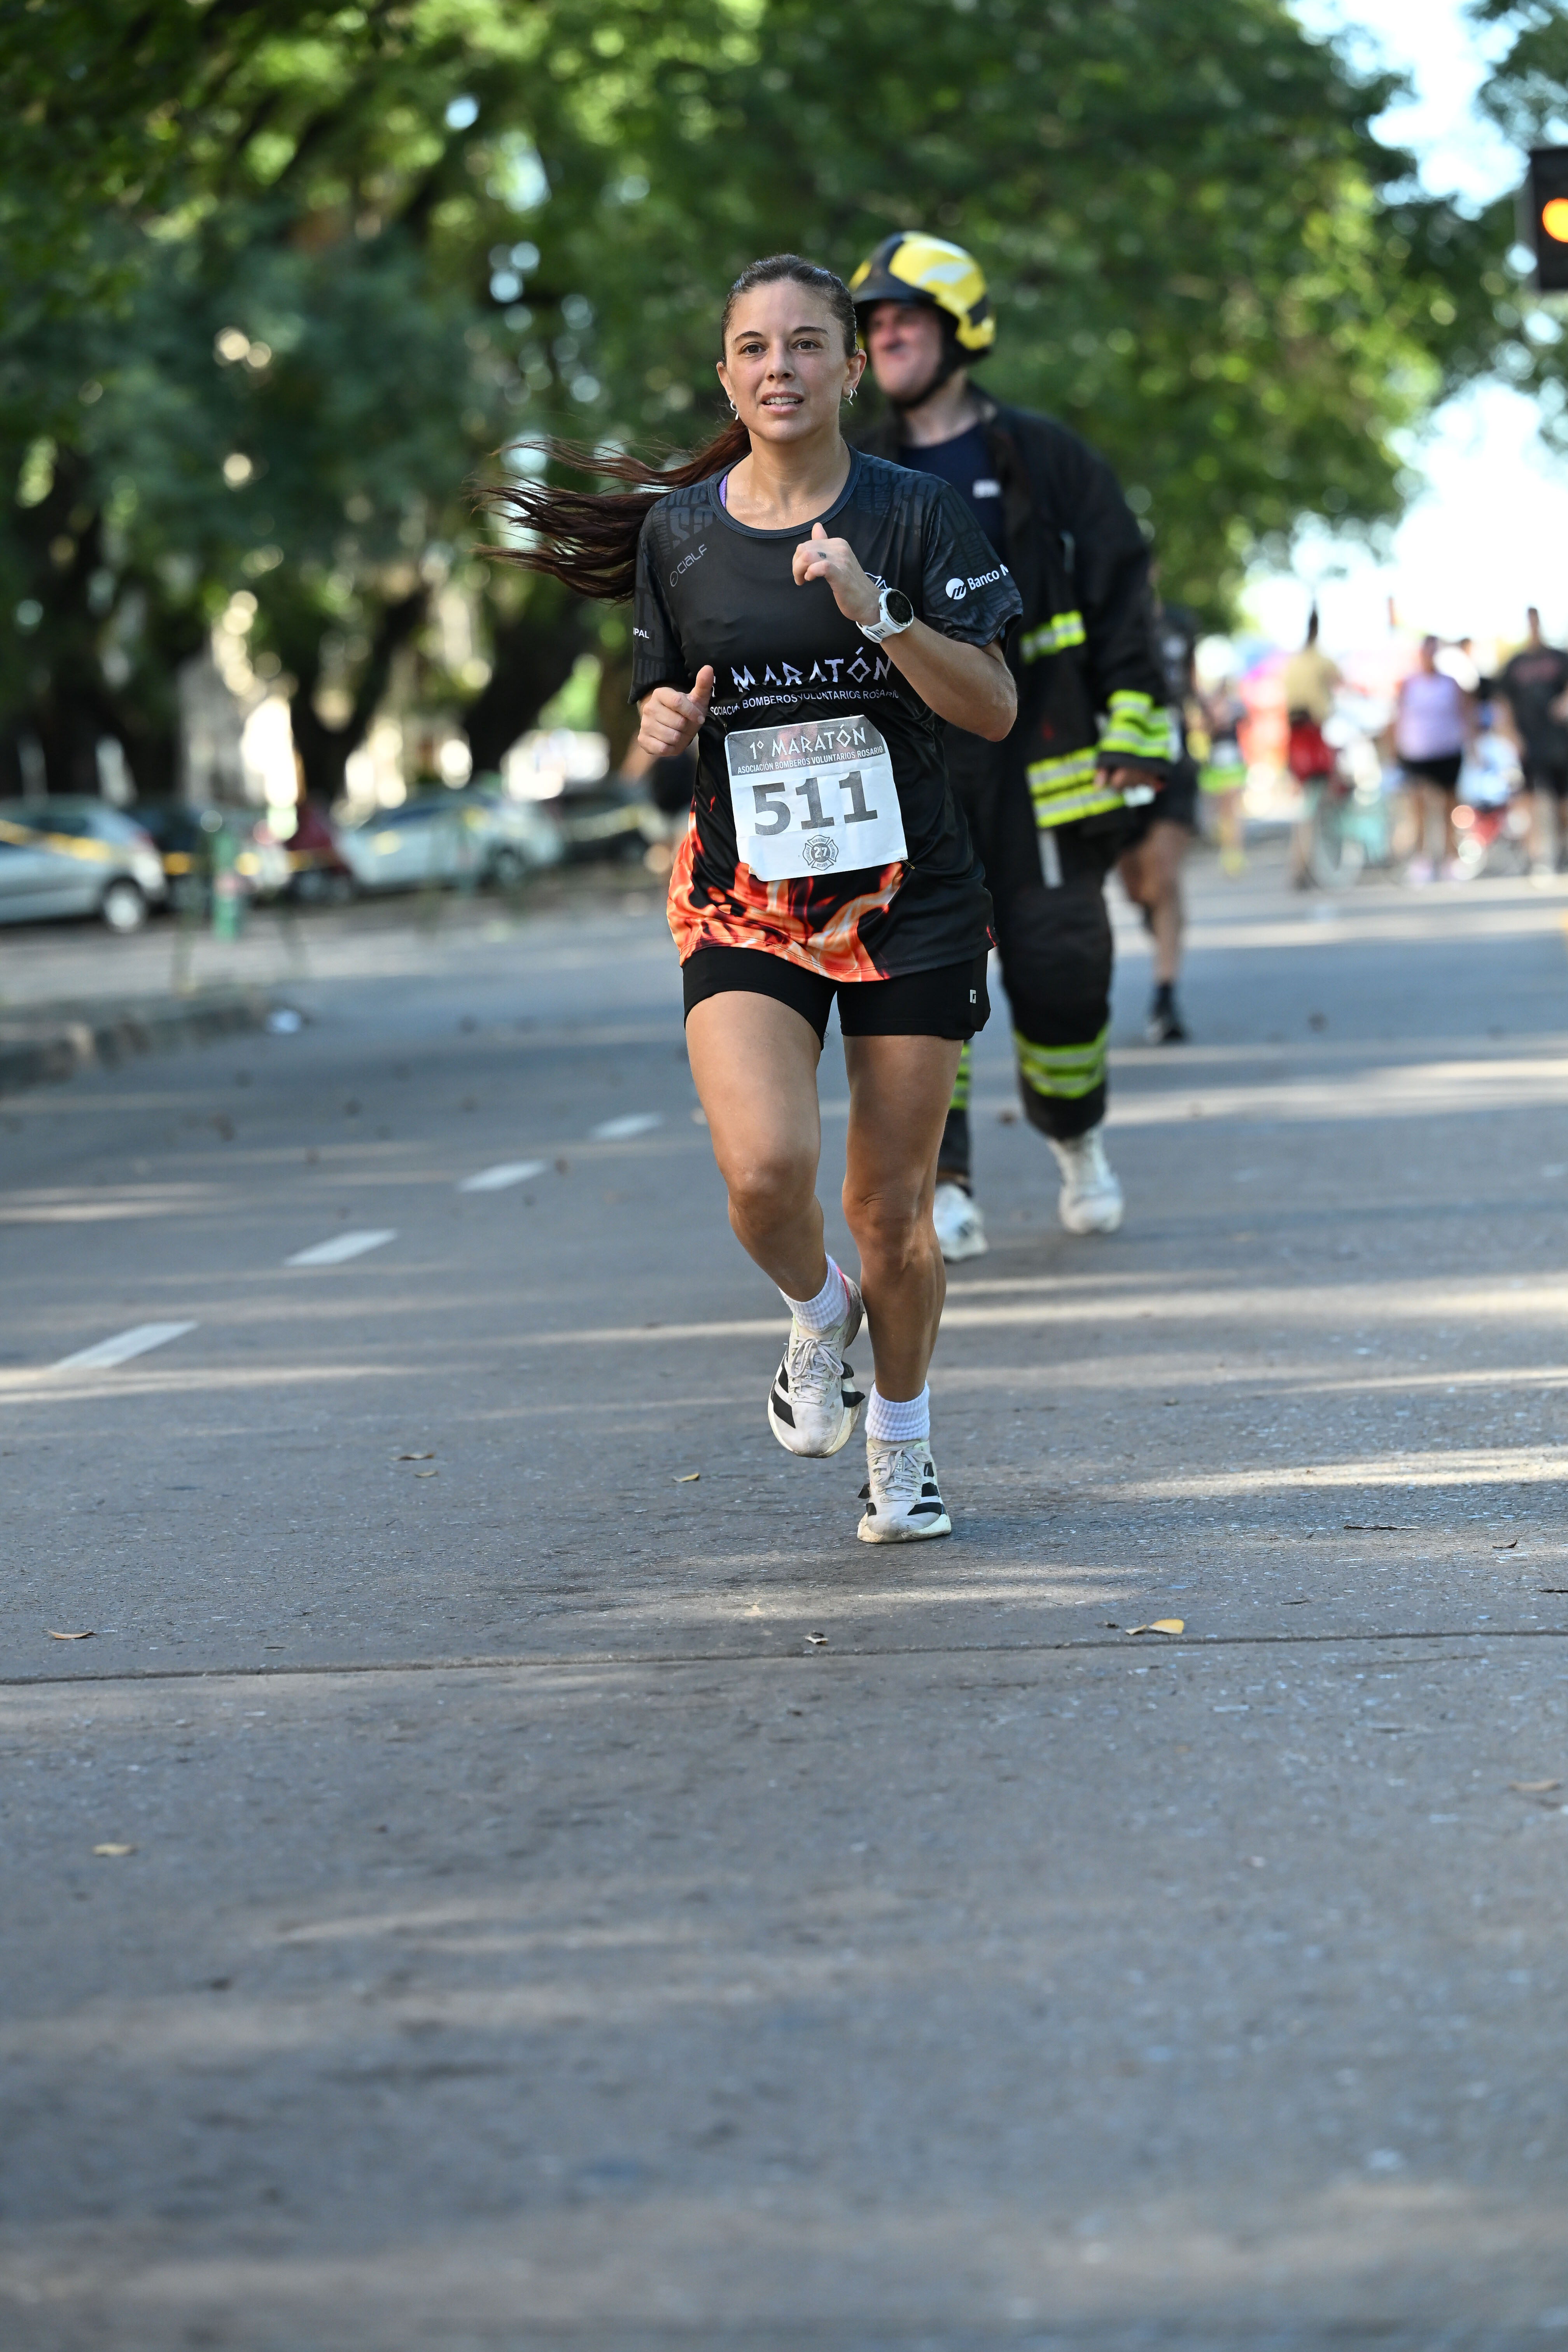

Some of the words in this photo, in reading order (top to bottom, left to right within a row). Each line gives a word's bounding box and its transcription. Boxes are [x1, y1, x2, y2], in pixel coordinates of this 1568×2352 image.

[967, 570, 999, 590] Banco
[731, 646, 892, 693] MARATÓN
[742, 694, 797, 709] BOMBEROS
[797, 690, 861, 700] VOLUNTARIOS
[772, 724, 866, 757] MARATÓN
[737, 761, 774, 774] ASOCIACIÓN
[775, 758, 810, 769] BOMBEROS
[811, 752, 856, 764] VOLUNTARIOS
[857, 746, 883, 758] ROSARIO
[752, 771, 878, 835] 511
[814, 846, 827, 858] 27
